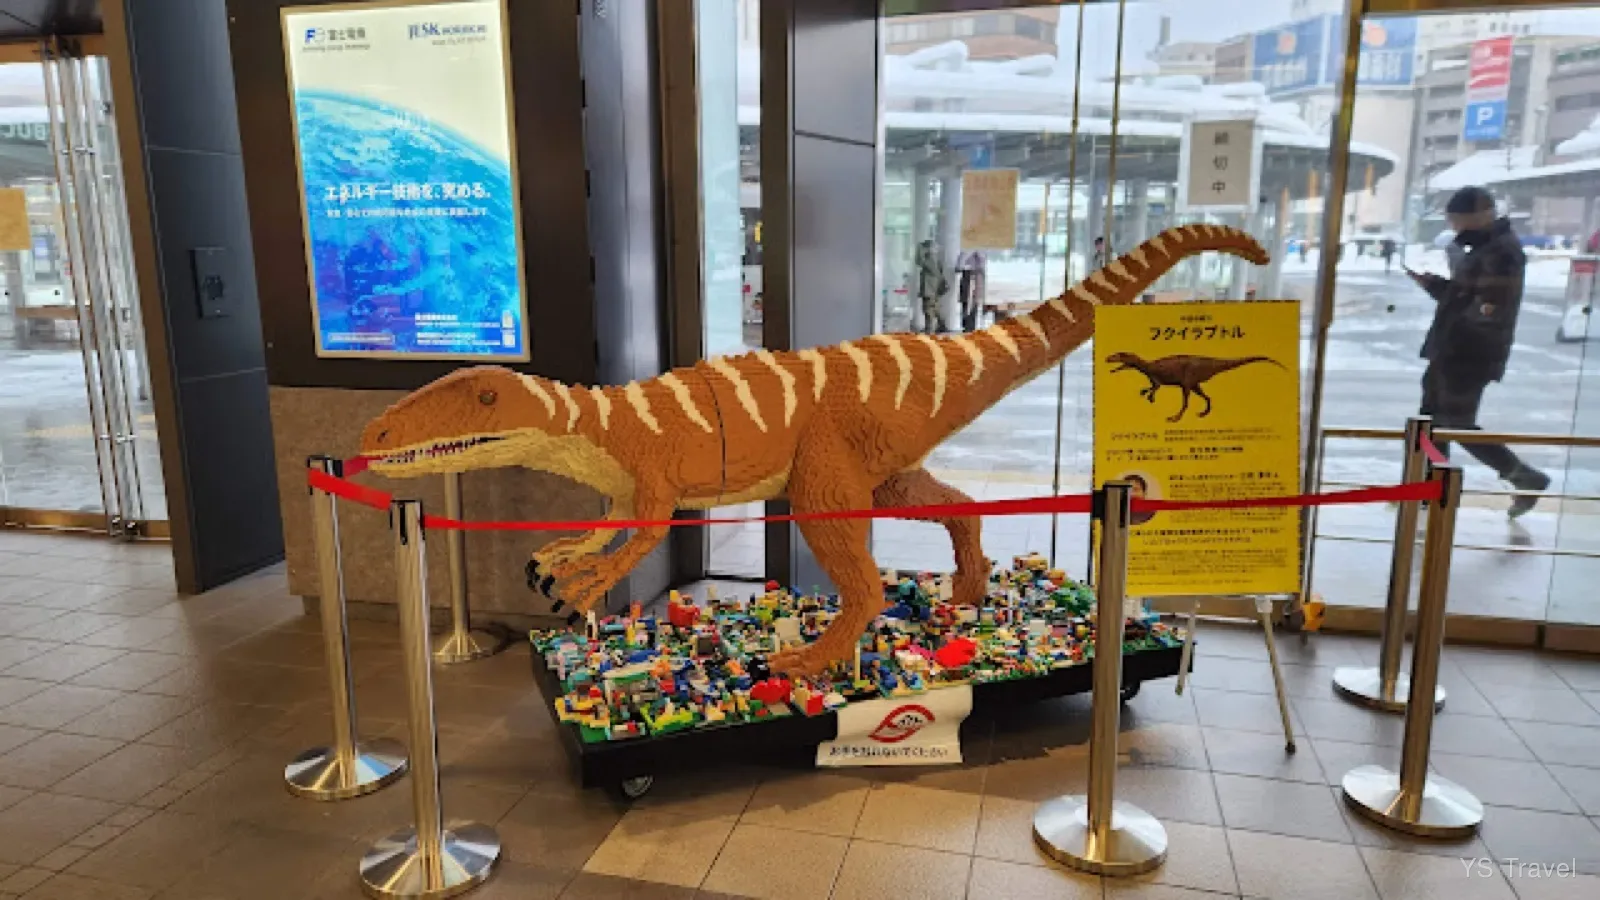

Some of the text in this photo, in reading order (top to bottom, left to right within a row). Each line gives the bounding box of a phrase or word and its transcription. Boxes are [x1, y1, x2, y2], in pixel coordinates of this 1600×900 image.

[1477, 107, 1493, 126] P
[1149, 324, 1245, 341] フクイラプトル
